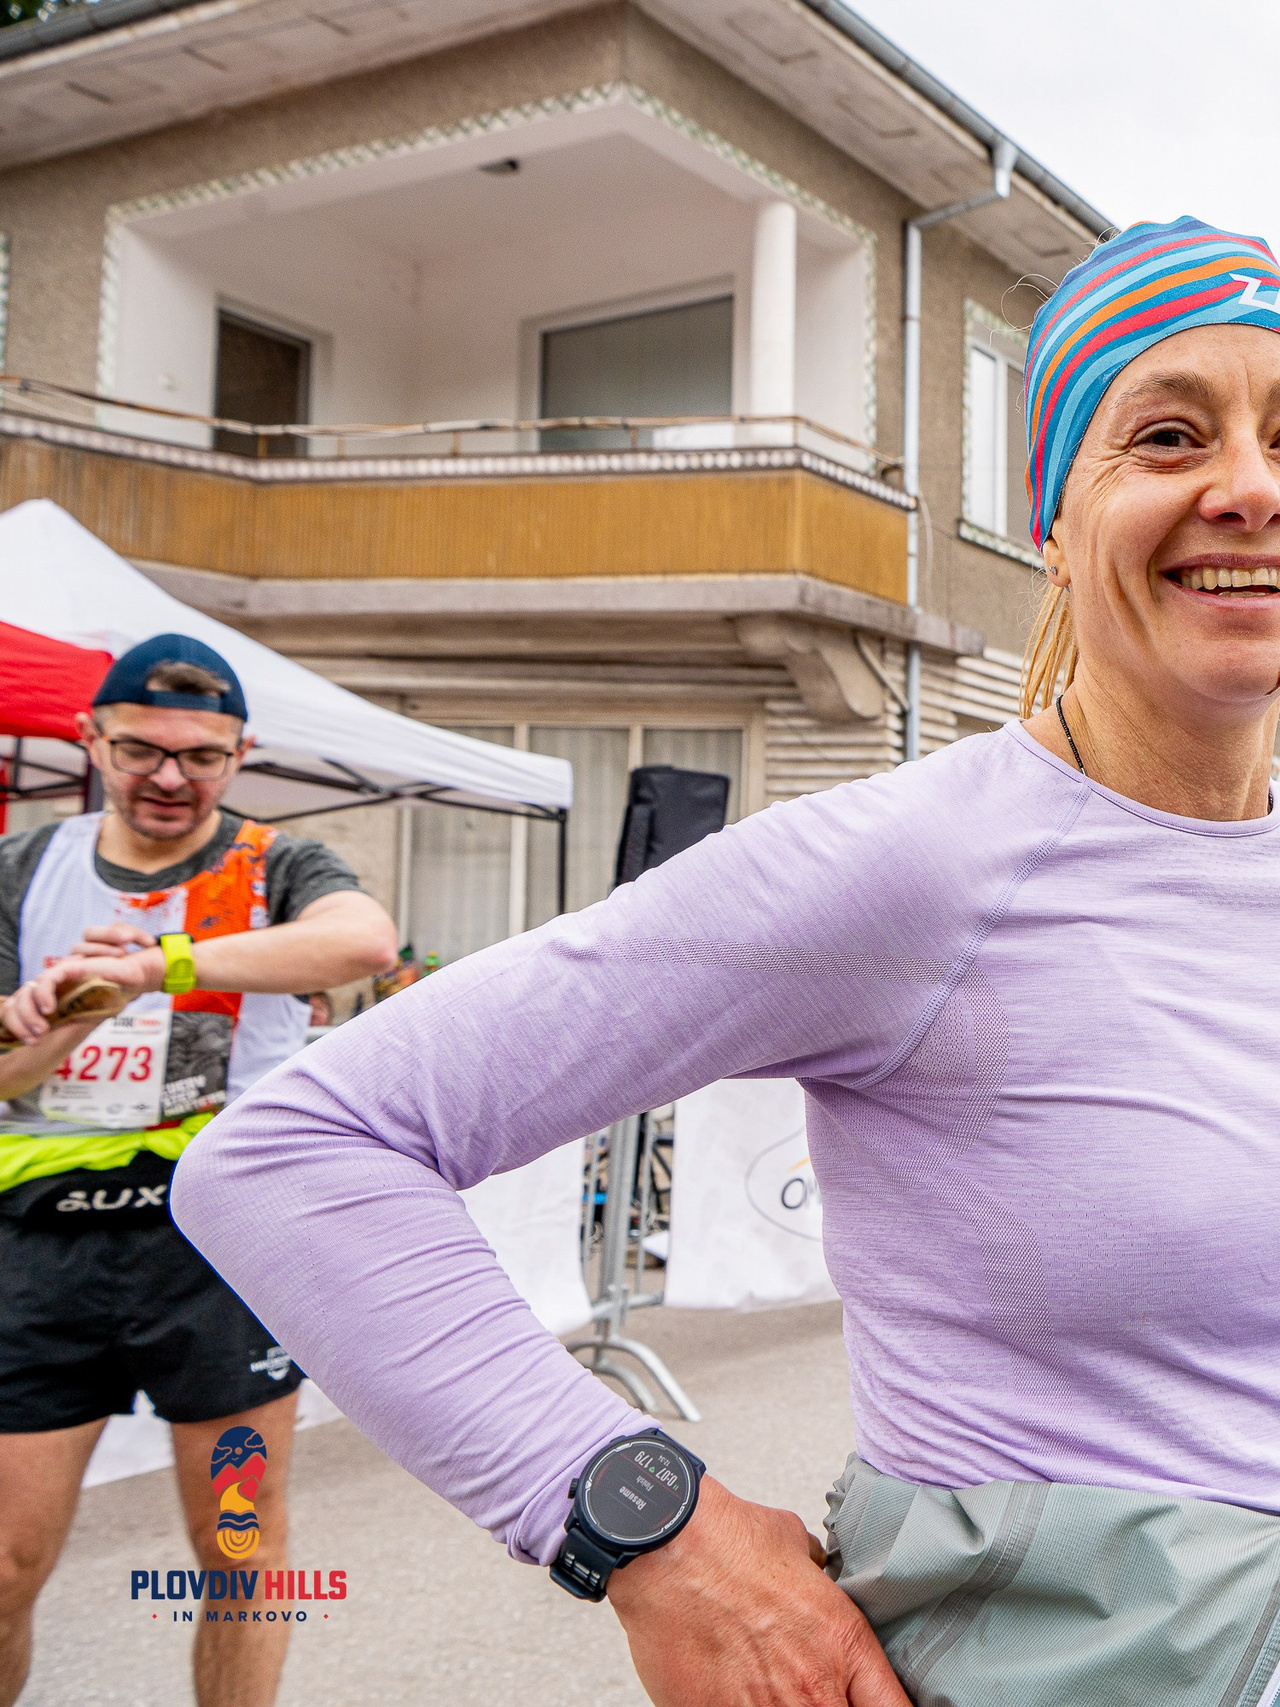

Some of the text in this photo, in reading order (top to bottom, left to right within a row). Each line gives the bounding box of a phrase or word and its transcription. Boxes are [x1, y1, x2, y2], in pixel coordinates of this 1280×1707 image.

[634, 1450, 678, 1487] 0:07 179
[636, 1475, 654, 1492] Finish
[619, 1485, 647, 1511] Resume
